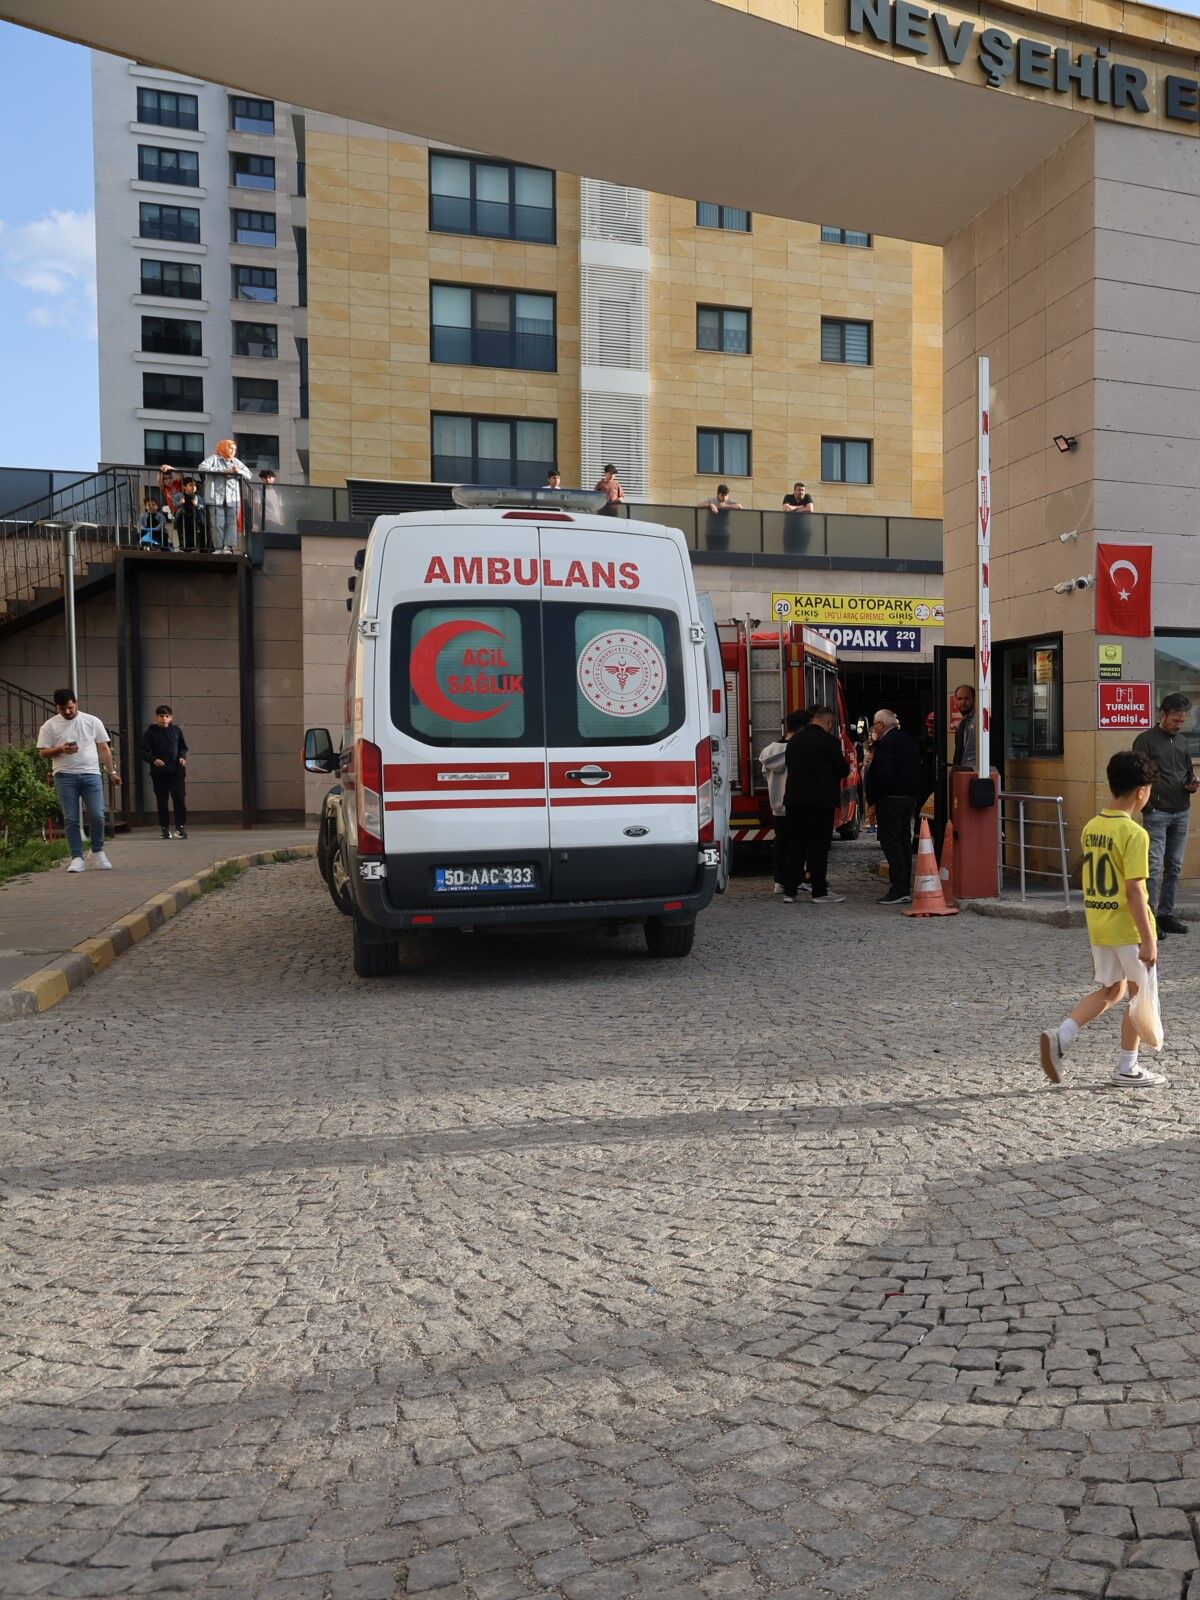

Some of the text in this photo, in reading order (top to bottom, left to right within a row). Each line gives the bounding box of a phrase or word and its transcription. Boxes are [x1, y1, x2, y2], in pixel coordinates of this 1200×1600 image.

[850, 0, 1149, 113] NEVŞEHİR
[424, 556, 640, 590] AMBULANS
[777, 603, 789, 612] 20
[794, 596, 844, 609] KAPALI
[848, 598, 913, 612] OTOPARK
[794, 609, 819, 618] ÇIKIŞ
[888, 612, 913, 621] GİRİŞ
[811, 628, 916, 648] TOPARK 220
[447, 672, 526, 696] SAĞLIK
[1105, 702, 1145, 711] TURNİKE
[1110, 713, 1138, 725] GİRİŞİ
[445, 867, 531, 885] 50 AAC 333
[1084, 851, 1119, 897] 10
